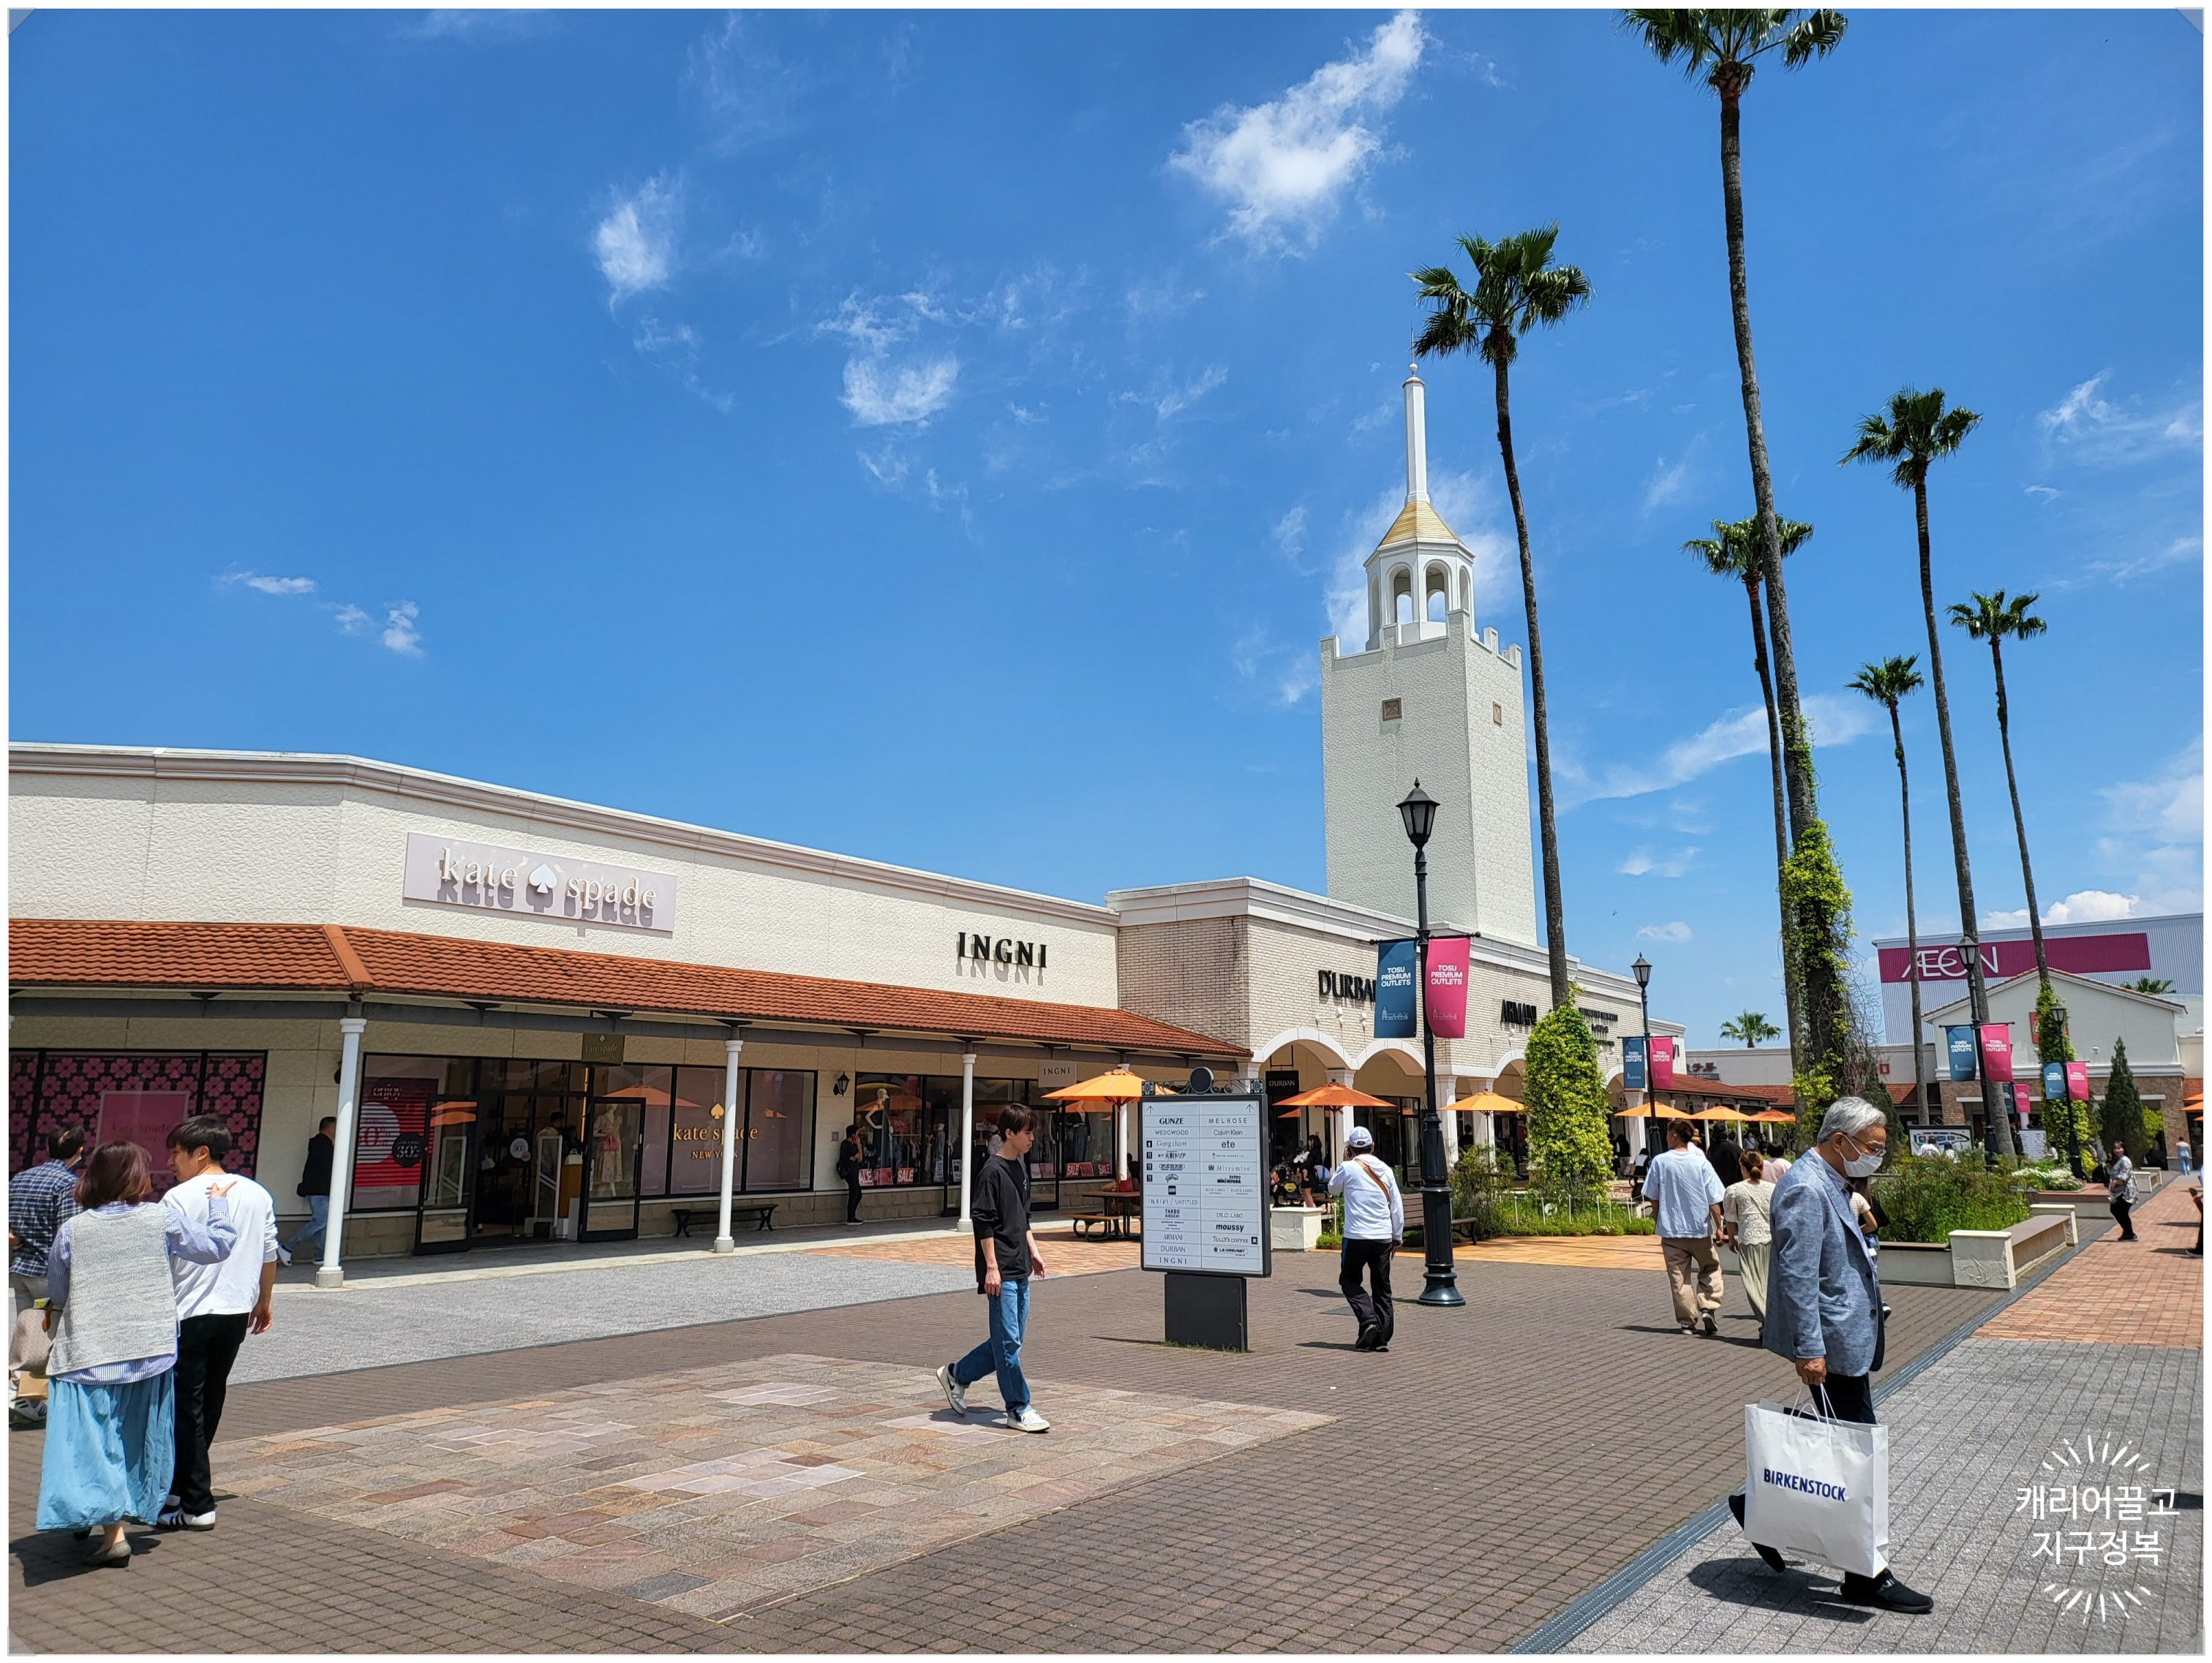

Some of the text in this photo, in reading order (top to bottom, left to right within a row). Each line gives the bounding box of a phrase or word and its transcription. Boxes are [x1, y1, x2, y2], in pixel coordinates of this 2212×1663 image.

[440, 847, 658, 909] kate spade
[958, 932, 1047, 968] INGNI
[1381, 972, 1411, 981] PREMIUM
[1380, 979, 1411, 987] OUTLETS
[585, 1043, 618, 1055] kate spade
[1043, 1067, 1071, 1076] INGNI
[372, 1084, 402, 1101] enjoy
[673, 1123, 707, 1141] kate
[1156, 1140, 1171, 1148] Gong
[1221, 1140, 1235, 1148] ete
[692, 1150, 712, 1159] NEW
[1066, 1164, 1080, 1175] SALE
[1098, 1164, 1111, 1174] SALE
[859, 1171, 873, 1183] ALE
[898, 1169, 914, 1183] SALE
[1216, 1224, 1244, 1232] moussy
[1764, 1468, 1846, 1502] BIRKENSTOCK
